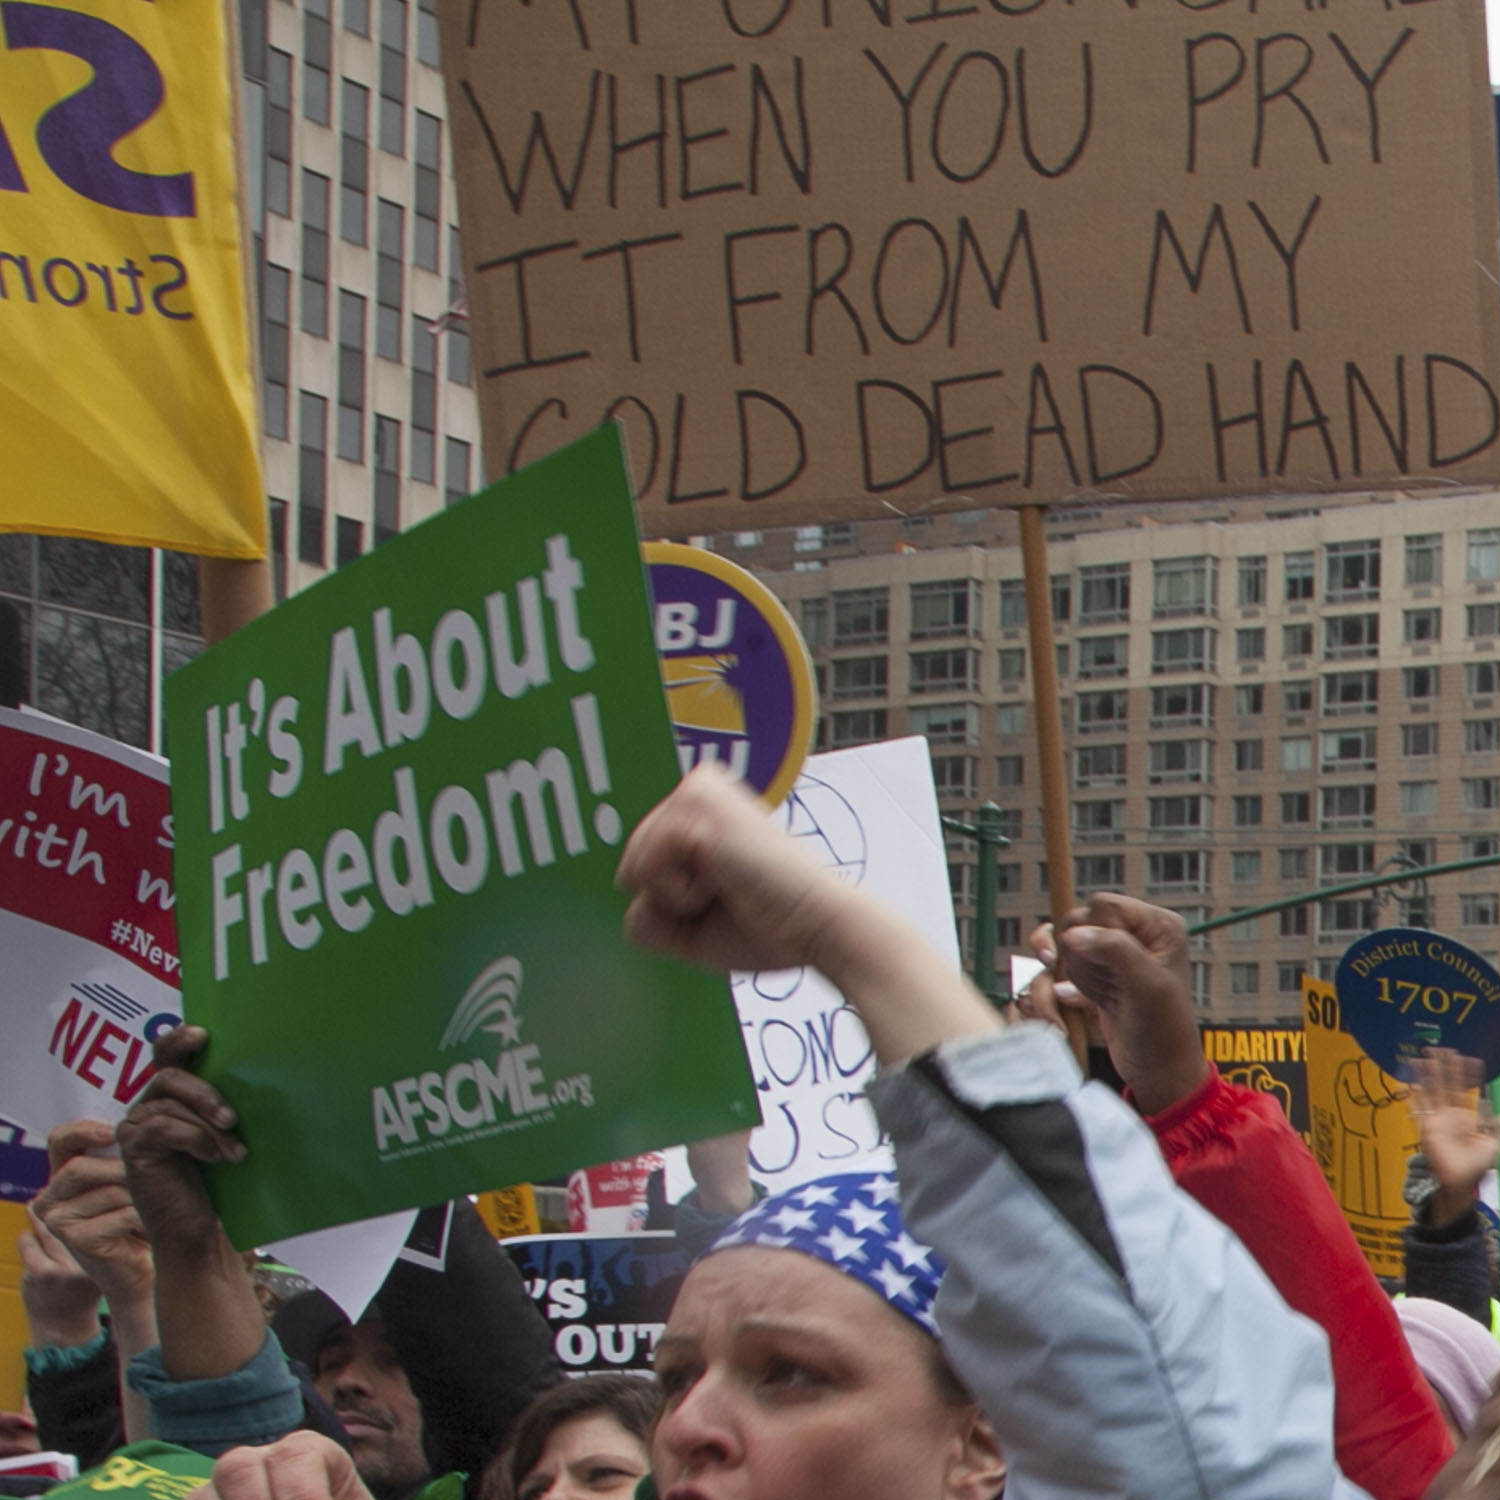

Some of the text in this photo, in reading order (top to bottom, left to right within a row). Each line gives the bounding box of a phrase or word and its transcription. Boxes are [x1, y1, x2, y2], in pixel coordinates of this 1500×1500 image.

[460, 27, 1417, 214] WHEN YOU PRY
[475, 195, 1323, 377] IT FROM MY
[508, 389, 810, 504] COLD
[856, 362, 1165, 493] DEAD
[655, 597, 737, 651] BJ
[205, 533, 596, 833] It's About
[29, 752, 131, 828] I'm
[209, 693, 623, 982] Freedom!
[111, 918, 183, 976] #Nev
[1350, 938, 1421, 979] District
[1376, 976, 1478, 1025] 1707
[1203, 1030, 1307, 1063] IDARITY!
